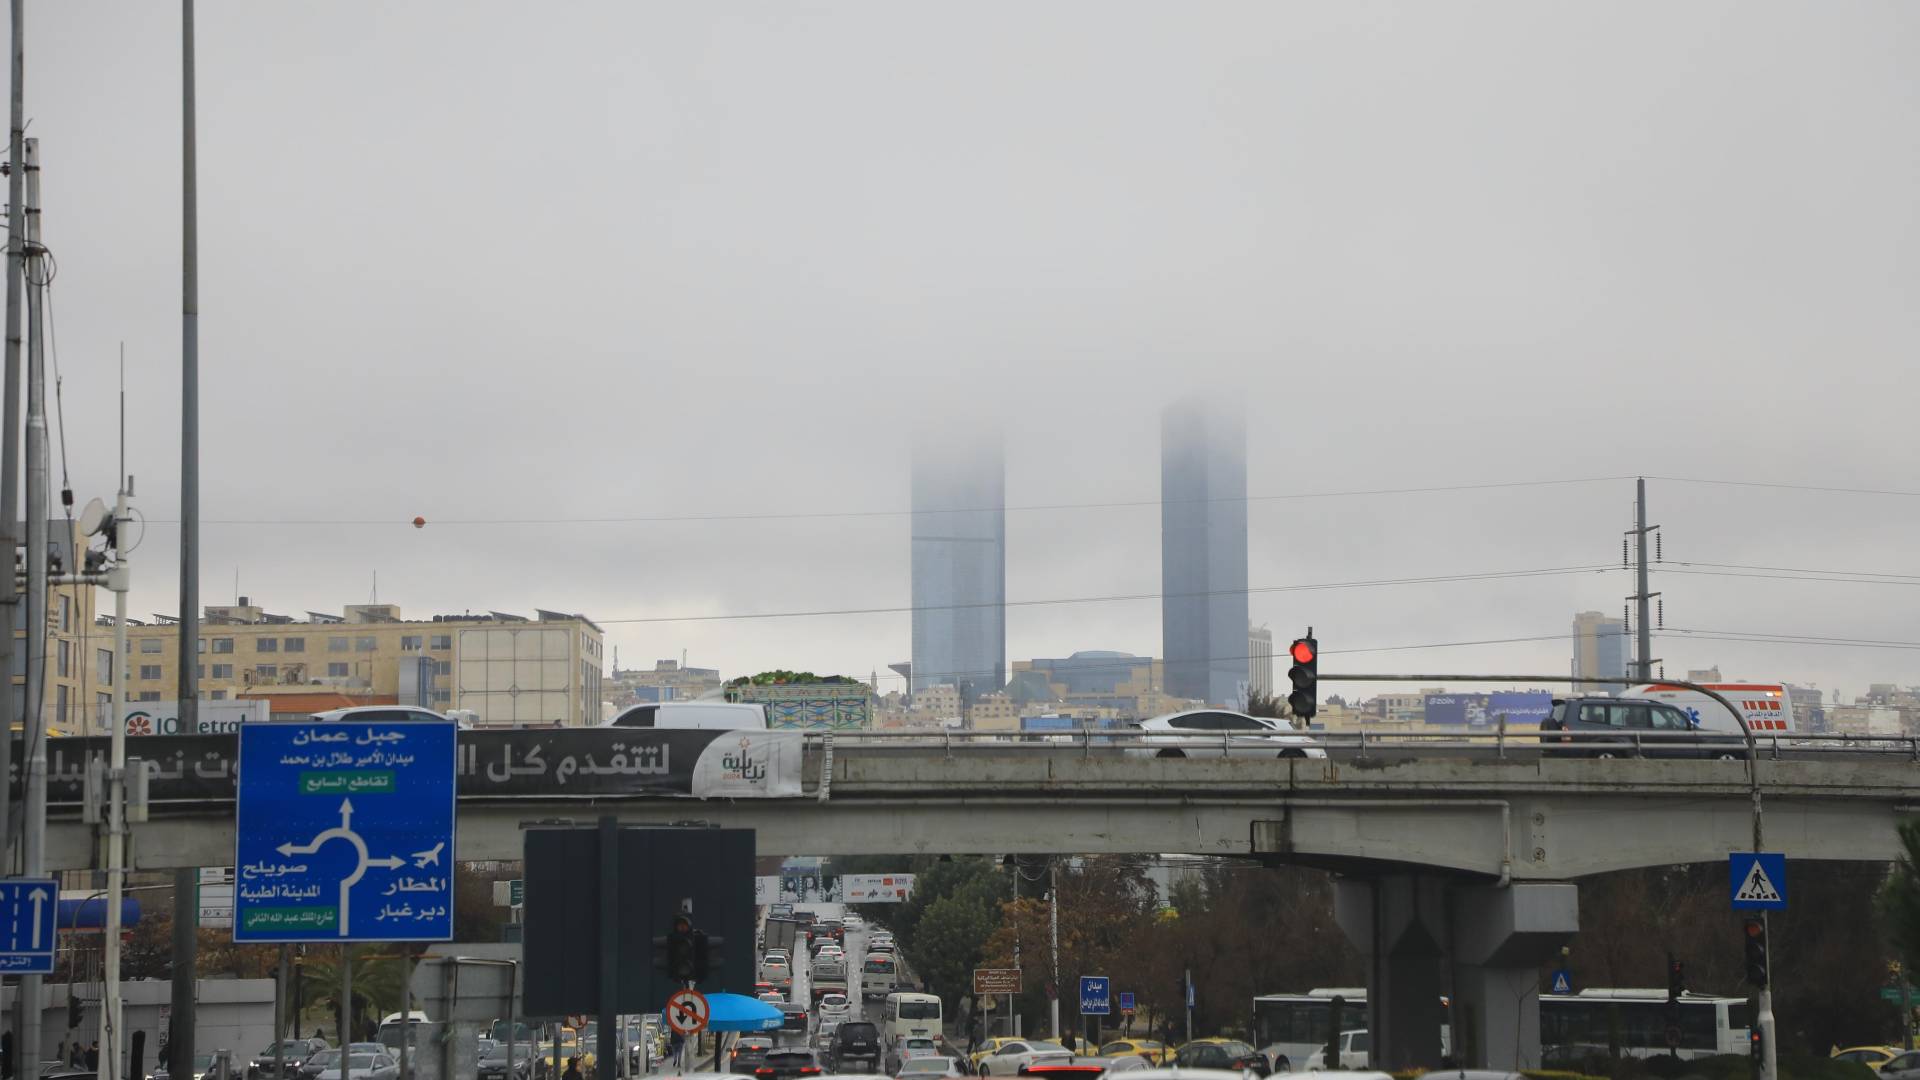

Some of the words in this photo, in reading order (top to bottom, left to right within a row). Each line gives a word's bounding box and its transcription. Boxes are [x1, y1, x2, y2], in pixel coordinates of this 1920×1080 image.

[1746, 711, 1763, 719] المدني
[1764, 711, 1782, 719] الدفاع
[292, 729, 349, 745] عمان
[355, 728, 405, 745] جبل
[280, 754, 309, 765] محمد
[312, 755, 326, 768] بن
[327, 752, 353, 766] طلال
[356, 750, 384, 767] الأمير
[385, 752, 414, 767] ميدان
[487, 744, 547, 782] كل
[307, 776, 347, 791] السابع
[348, 776, 388, 791] تقاطع
[243, 860, 308, 879] صويلح
[240, 883, 280, 903] الطبية
[281, 884, 320, 901] المدينة
[381, 877, 446, 895] المطار
[247, 912, 270, 927] الثاني
[270, 912, 283, 922] الله
[284, 913, 299, 924] عبد
[300, 912, 317, 921] الملك
[317, 910, 334, 926] شارع
[375, 902, 413, 922] غبار
[414, 906, 445, 921] دير
[1087, 980, 1103, 993] ميدان
